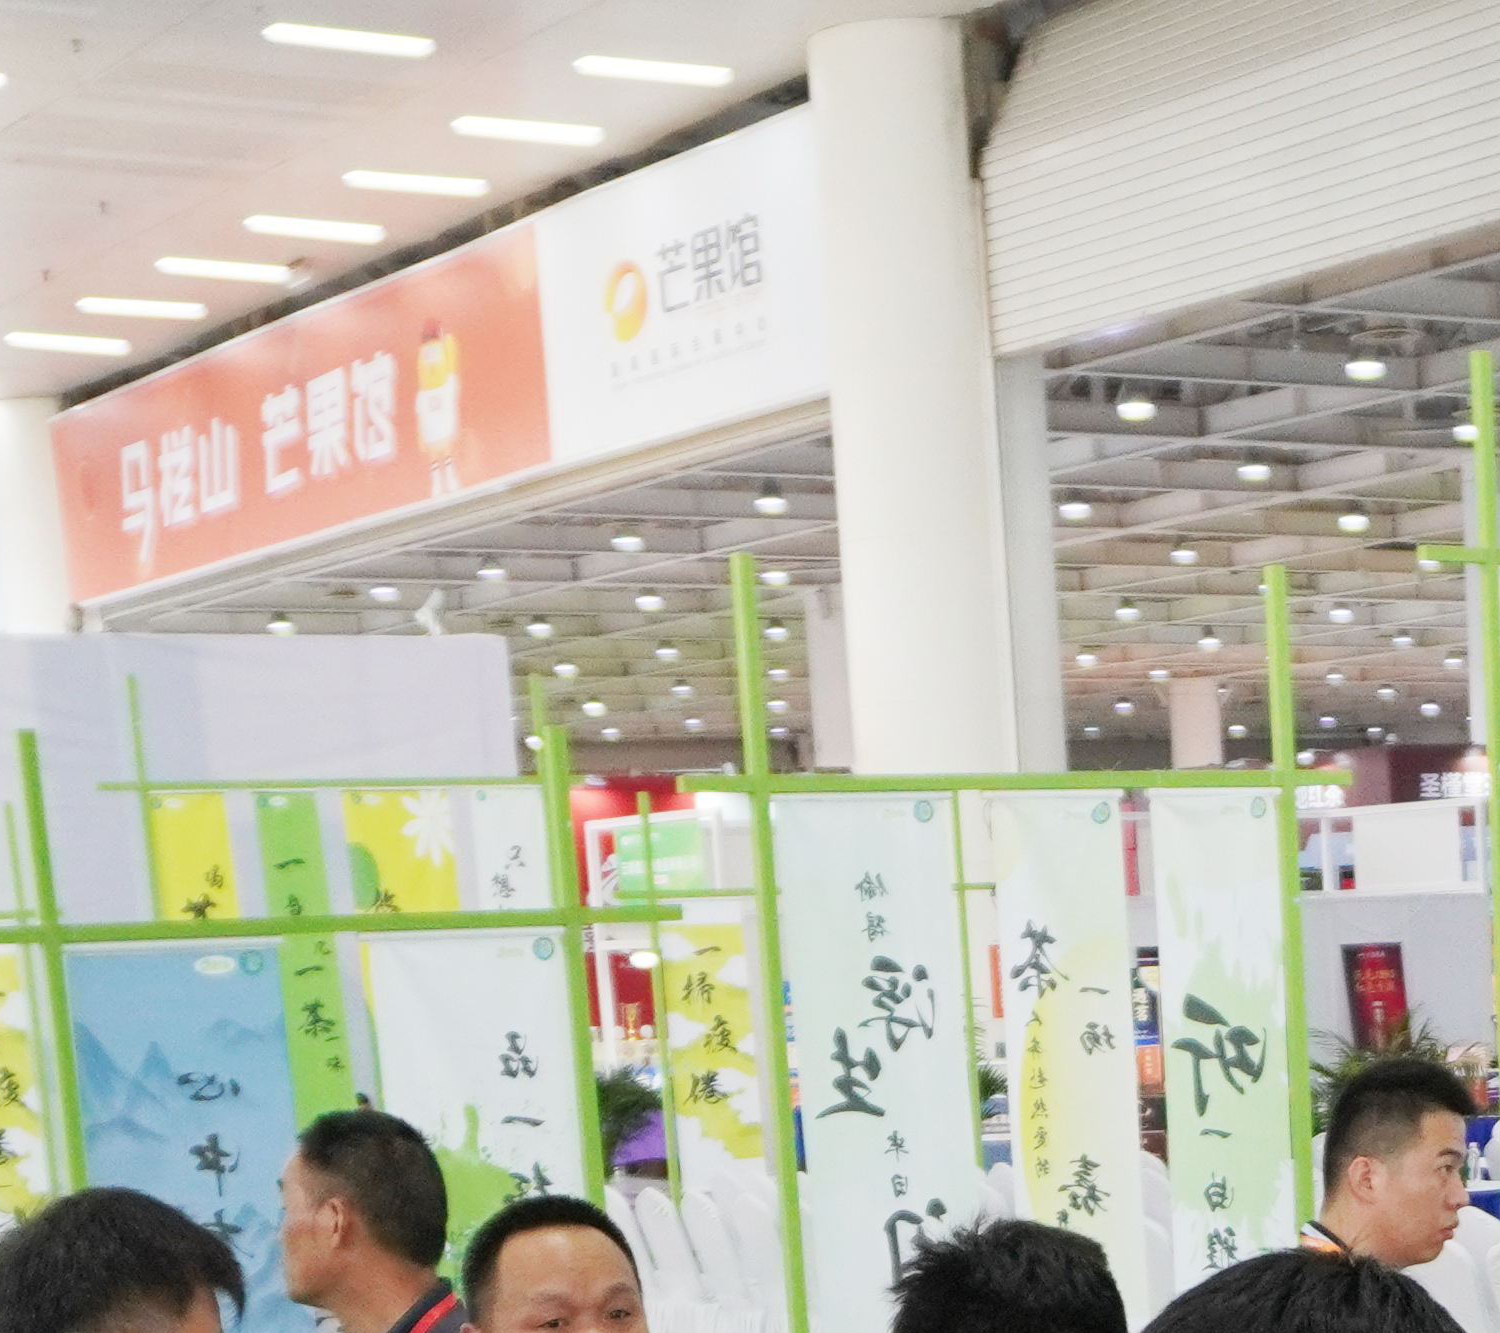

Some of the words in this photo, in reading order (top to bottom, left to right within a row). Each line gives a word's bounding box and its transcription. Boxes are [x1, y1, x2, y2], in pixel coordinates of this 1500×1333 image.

[656, 212, 764, 316] 芒果馆
[261, 350, 400, 499] 芒果馆
